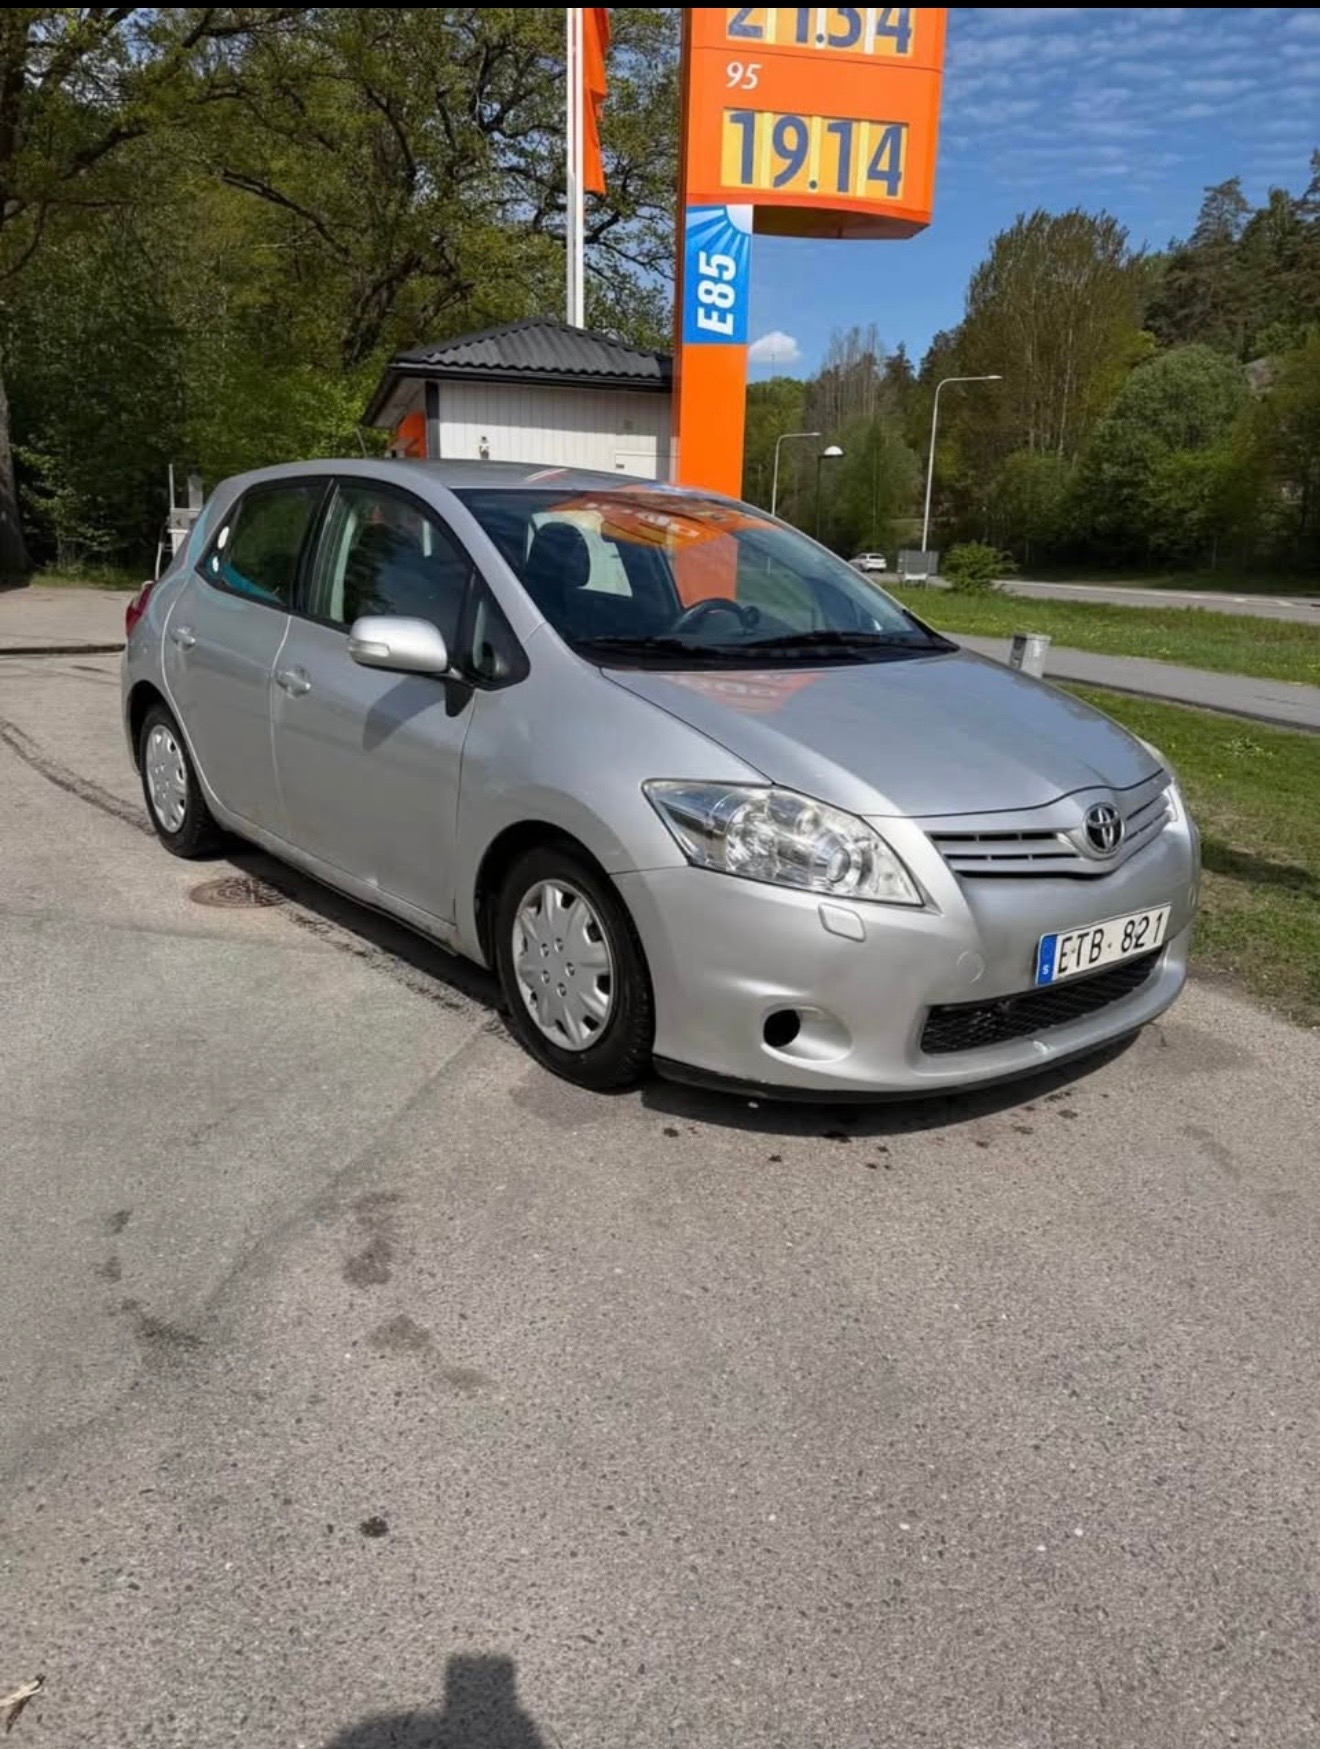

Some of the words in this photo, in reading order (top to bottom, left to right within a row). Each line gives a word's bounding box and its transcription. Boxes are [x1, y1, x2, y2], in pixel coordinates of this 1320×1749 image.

[726, 61, 762, 90] 95
[730, 110, 902, 196] 19.14
[697, 251, 736, 335] E85
[1042, 964, 1050, 975] S
[1058, 928, 1104, 973] ETB
[1121, 911, 1163, 952] 821
